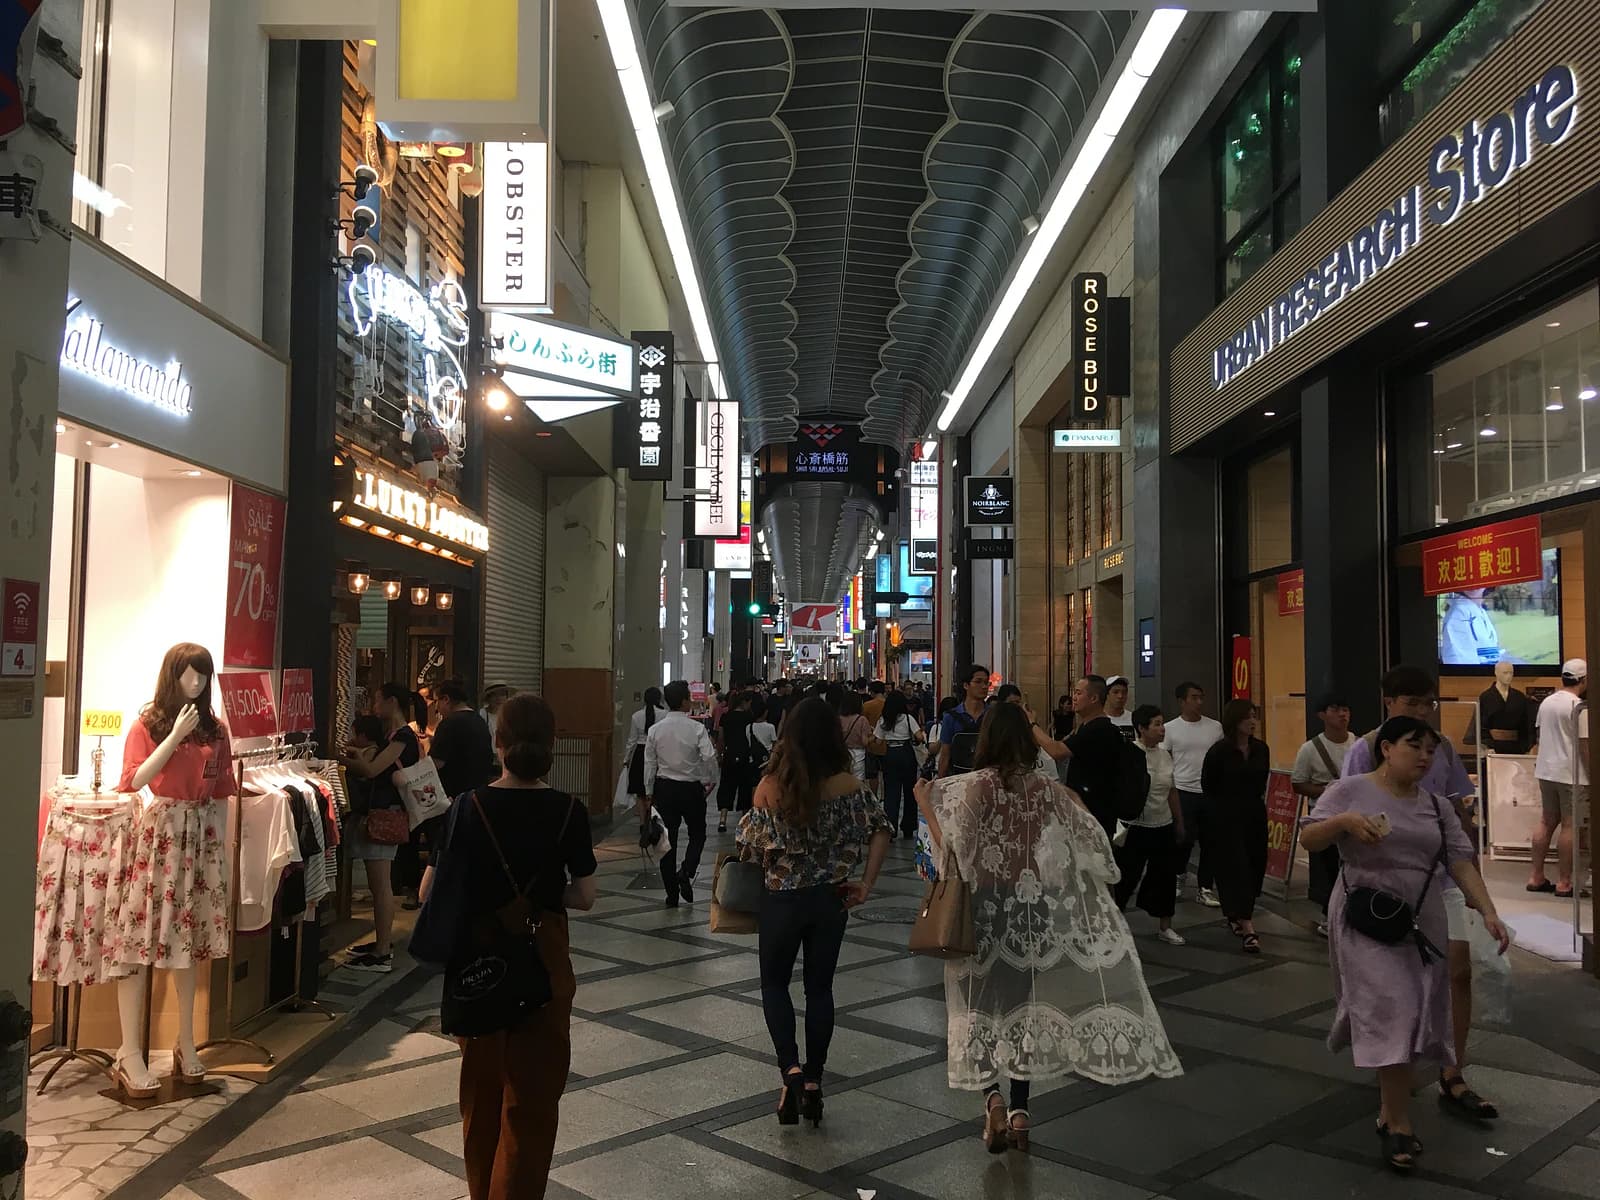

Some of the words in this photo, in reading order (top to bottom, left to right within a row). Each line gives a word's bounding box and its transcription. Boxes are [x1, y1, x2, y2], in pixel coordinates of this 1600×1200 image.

[1209, 305, 1273, 391] URBAN
[1277, 185, 1422, 346] RESEARCH
[1427, 64, 1578, 227] Store
[1084, 279, 1099, 352] ROSE
[1084, 360, 1099, 411] BUD
[248, 509, 272, 532] SALE
[1457, 533, 1494, 549] WELCOME
[233, 561, 265, 620] 70
[14, 649, 25, 670] 4
